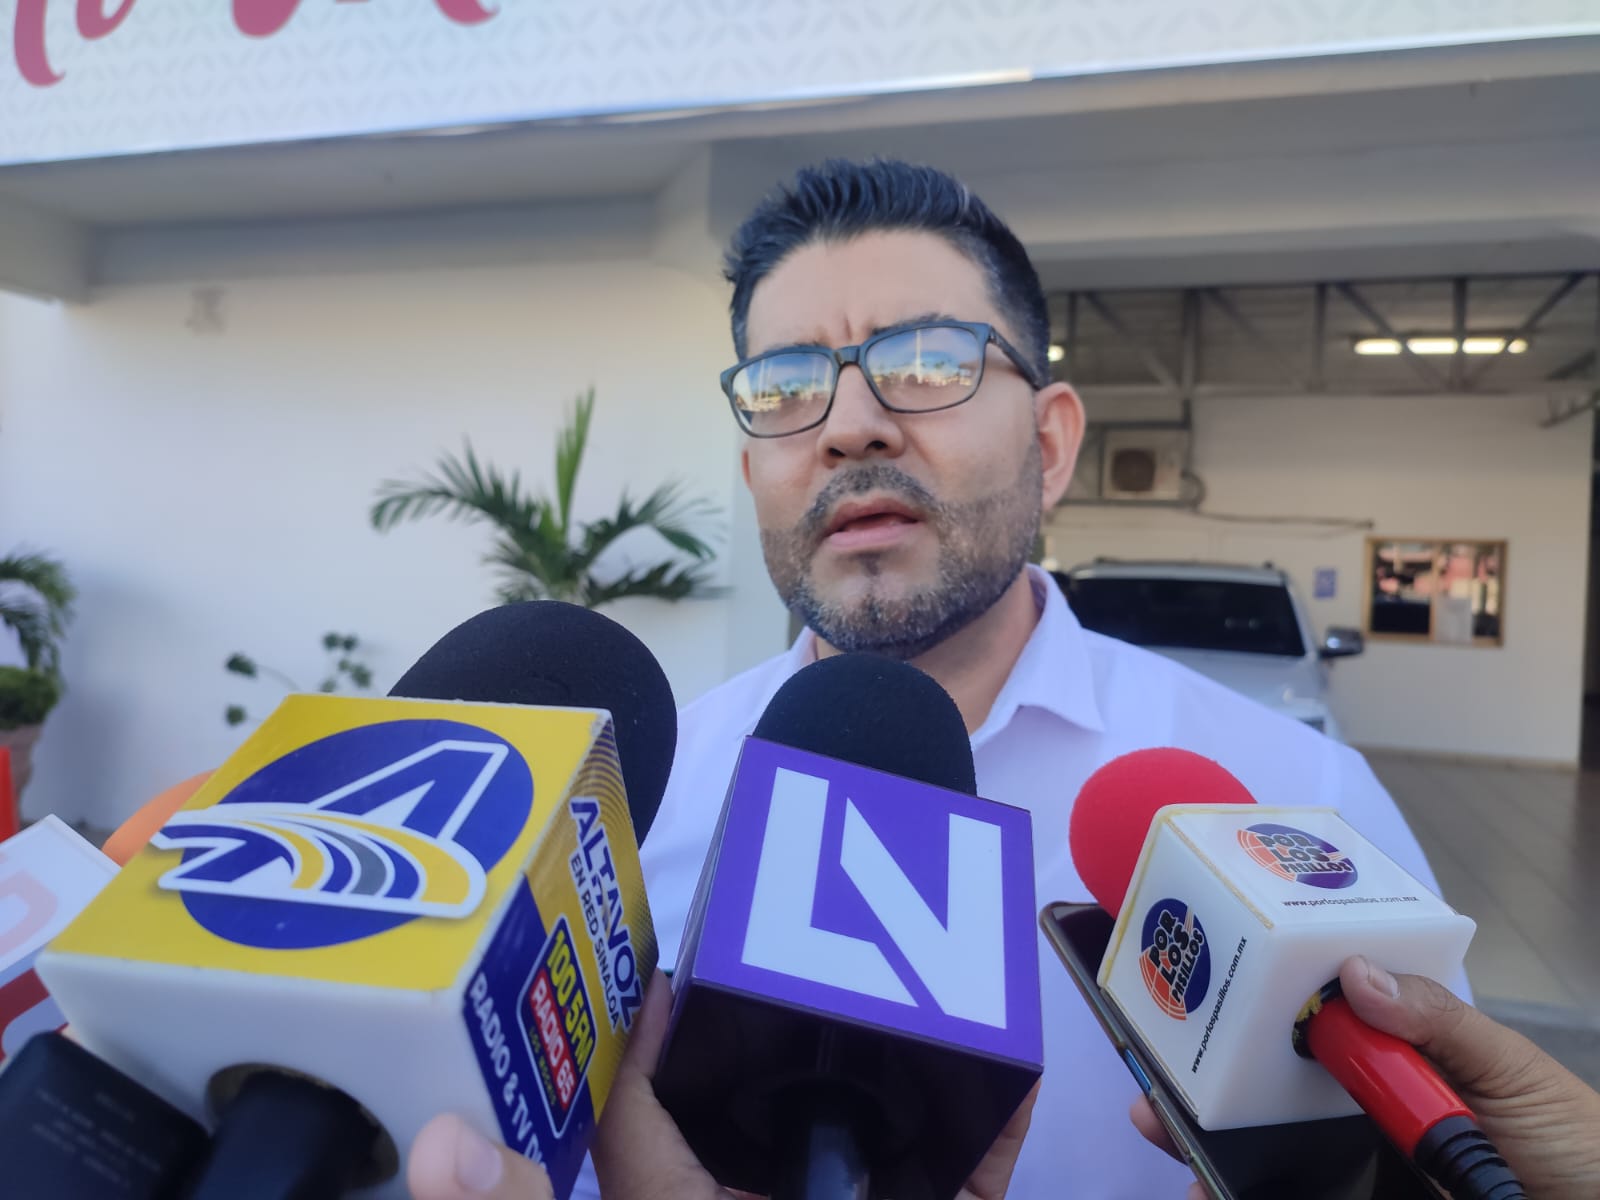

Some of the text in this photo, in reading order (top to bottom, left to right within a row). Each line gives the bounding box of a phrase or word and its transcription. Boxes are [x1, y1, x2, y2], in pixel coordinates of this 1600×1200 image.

[1257, 834, 1316, 848] POR
[1270, 847, 1330, 863] LOS
[1279, 861, 1353, 874] PASILLOS
[570, 801, 642, 1027] ALTAVOZ
[570, 853, 619, 1028] EN RED SINALOA
[1149, 910, 1178, 969] POR
[1160, 923, 1190, 986] LOS
[1171, 928, 1204, 1003] PASILLOS
[531, 976, 565, 1068] RADIO
[1191, 936, 1247, 1074] www.porlospasillos.com.mx
[469, 971, 511, 1079] RADIO
[503, 1071, 518, 1106] &
[511, 1092, 533, 1142] TV
